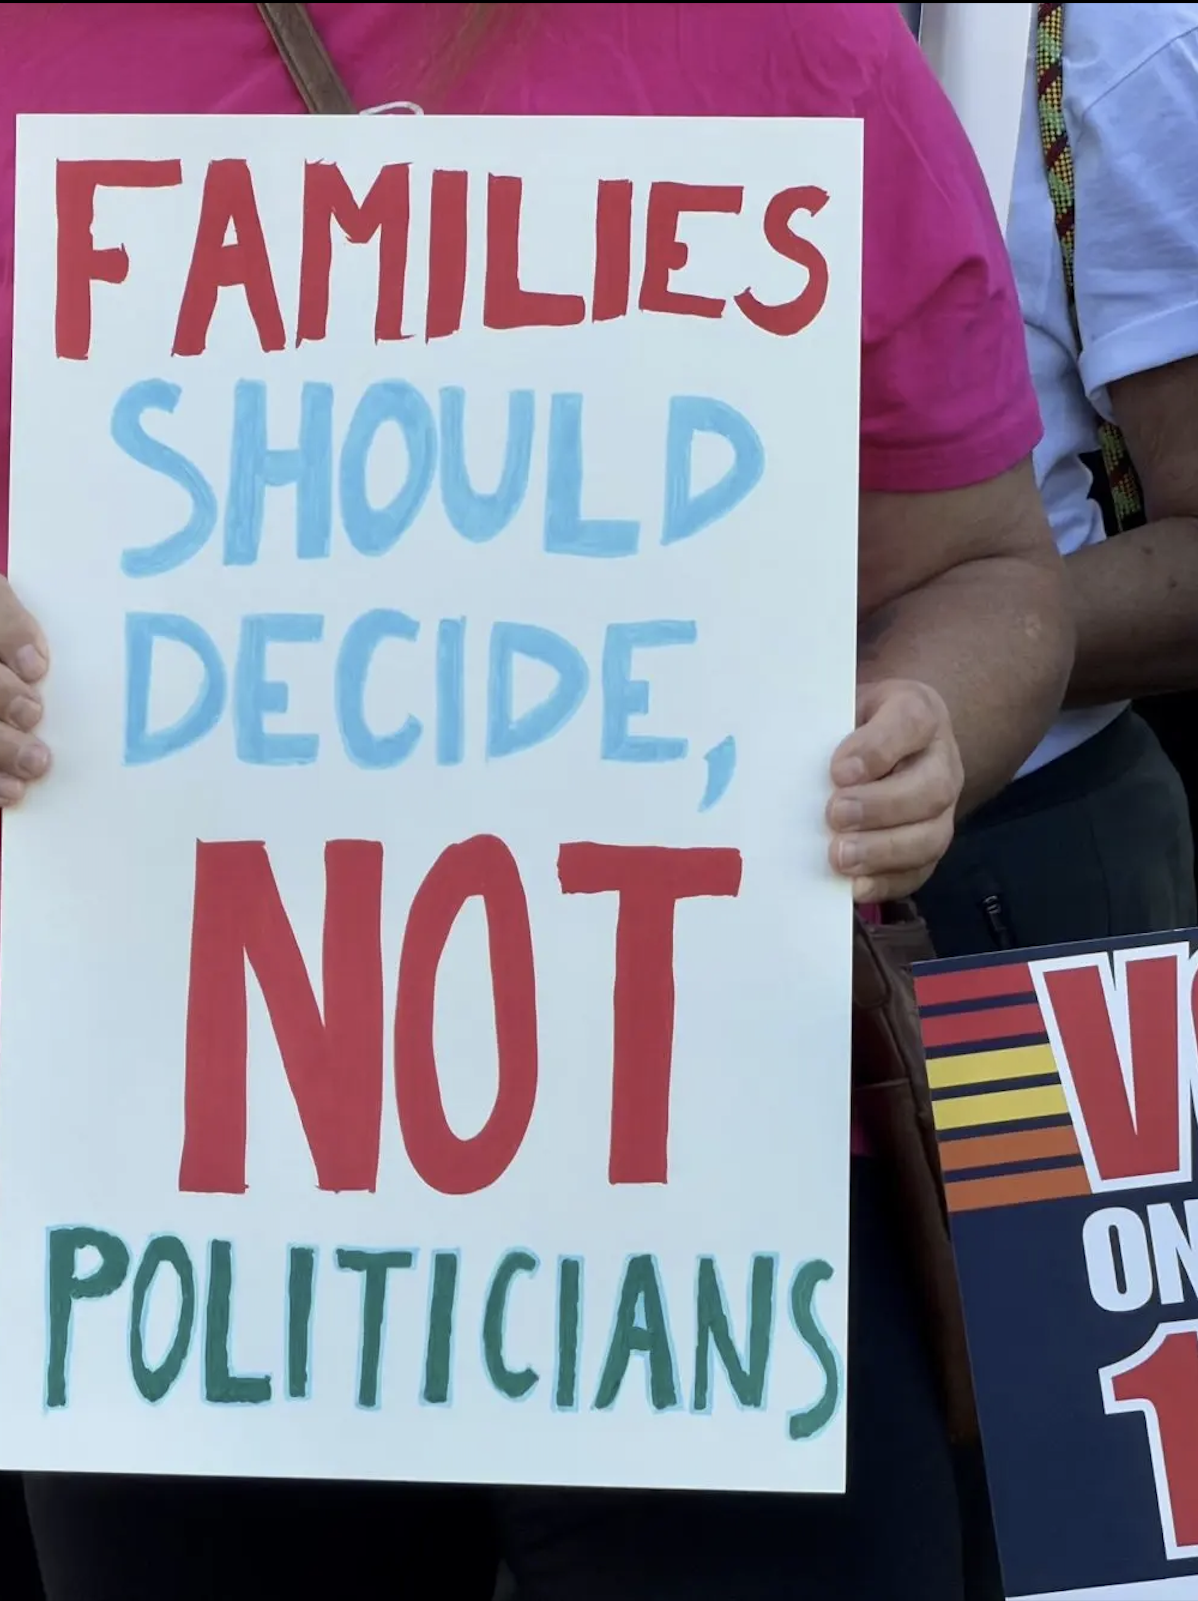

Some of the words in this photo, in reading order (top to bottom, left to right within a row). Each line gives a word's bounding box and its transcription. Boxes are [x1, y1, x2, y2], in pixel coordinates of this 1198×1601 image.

[54, 157, 831, 361] FAMILIES
[110, 377, 766, 578] SHOULD
[122, 607, 738, 813] DECIDE,
[178, 833, 744, 1195] NOT
[42, 1221, 845, 1442] POLITICIANS
